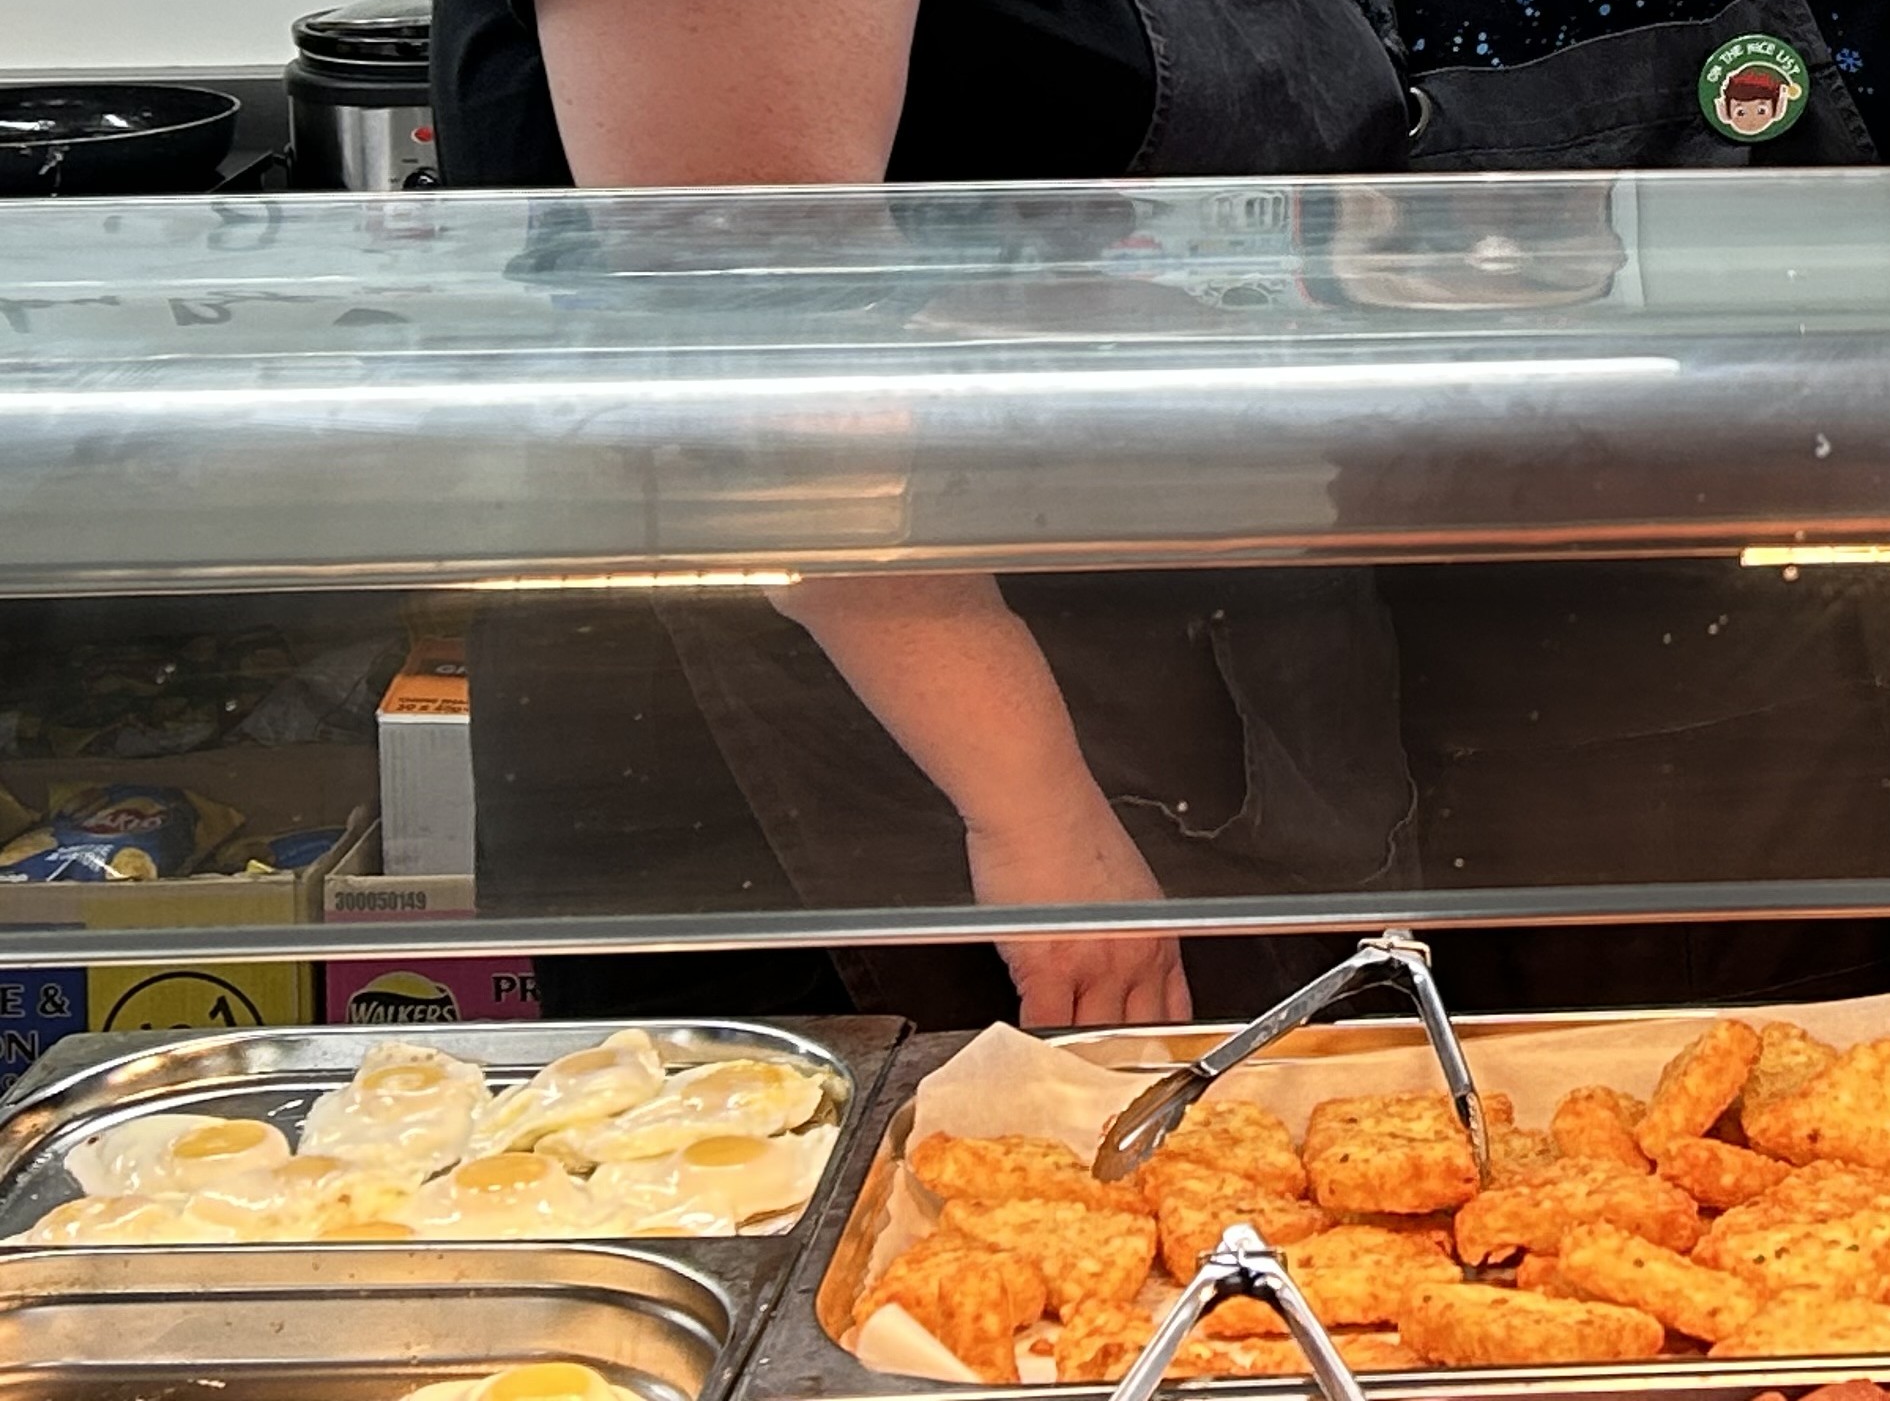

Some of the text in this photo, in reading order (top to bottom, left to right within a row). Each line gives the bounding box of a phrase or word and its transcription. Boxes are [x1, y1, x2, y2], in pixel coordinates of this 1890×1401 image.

[1719, 44, 1744, 64] THE
[1747, 41, 1776, 56] NICE
[1776, 49, 1800, 75] LIST
[334, 891, 427, 911] 300050149
[350, 1000, 457, 1024] WALKERS
